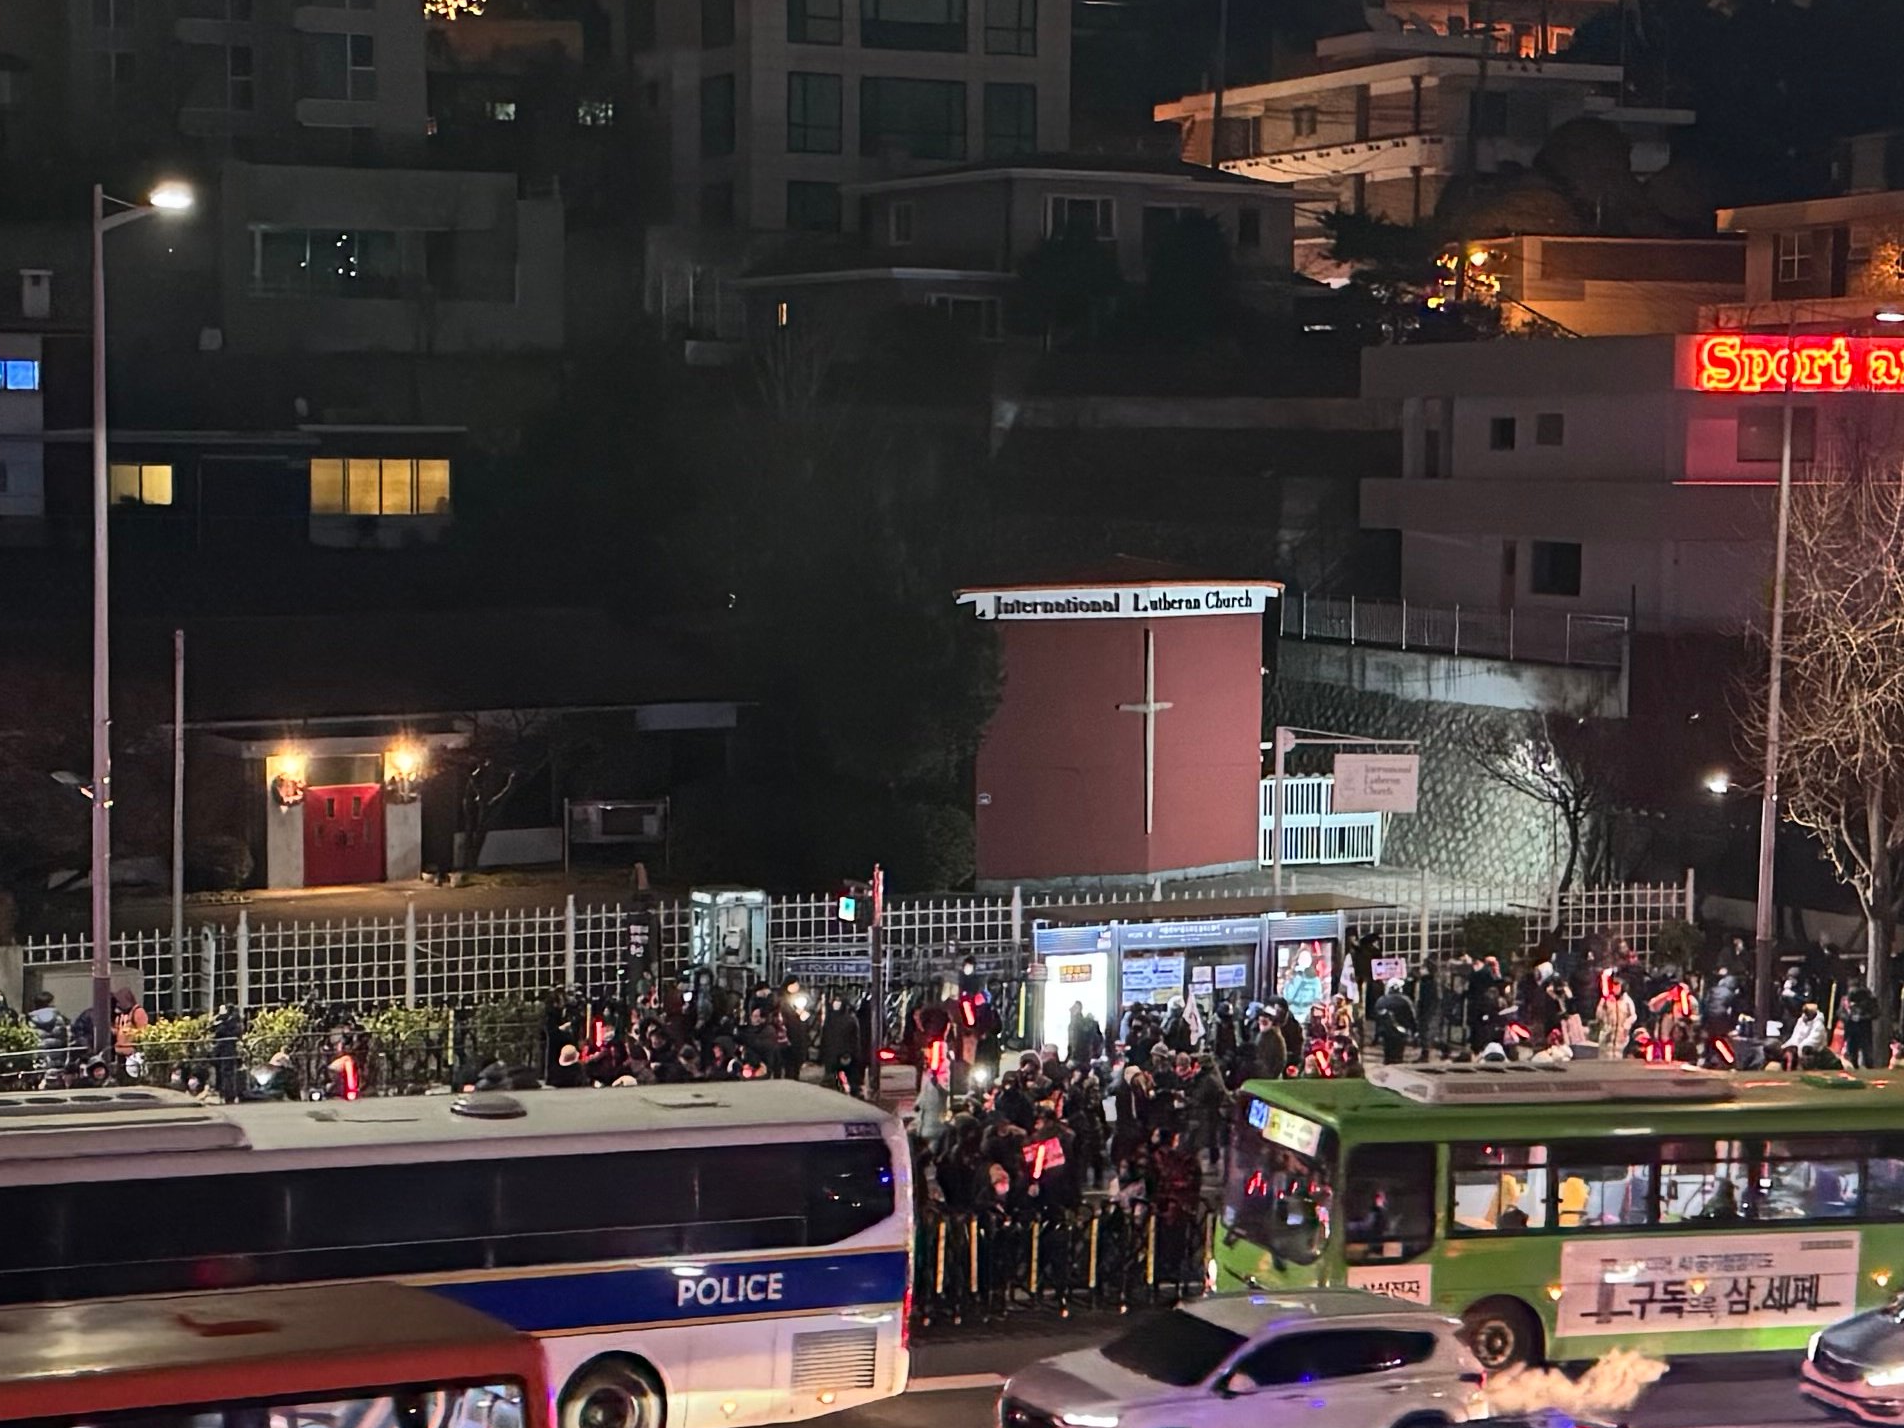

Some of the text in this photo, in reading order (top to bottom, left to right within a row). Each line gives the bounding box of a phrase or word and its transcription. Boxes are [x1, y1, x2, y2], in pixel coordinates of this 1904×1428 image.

[1702, 335, 1851, 391] Sport
[997, 589, 1253, 615] International Lutheran Church
[677, 1273, 784, 1307] POLICE
